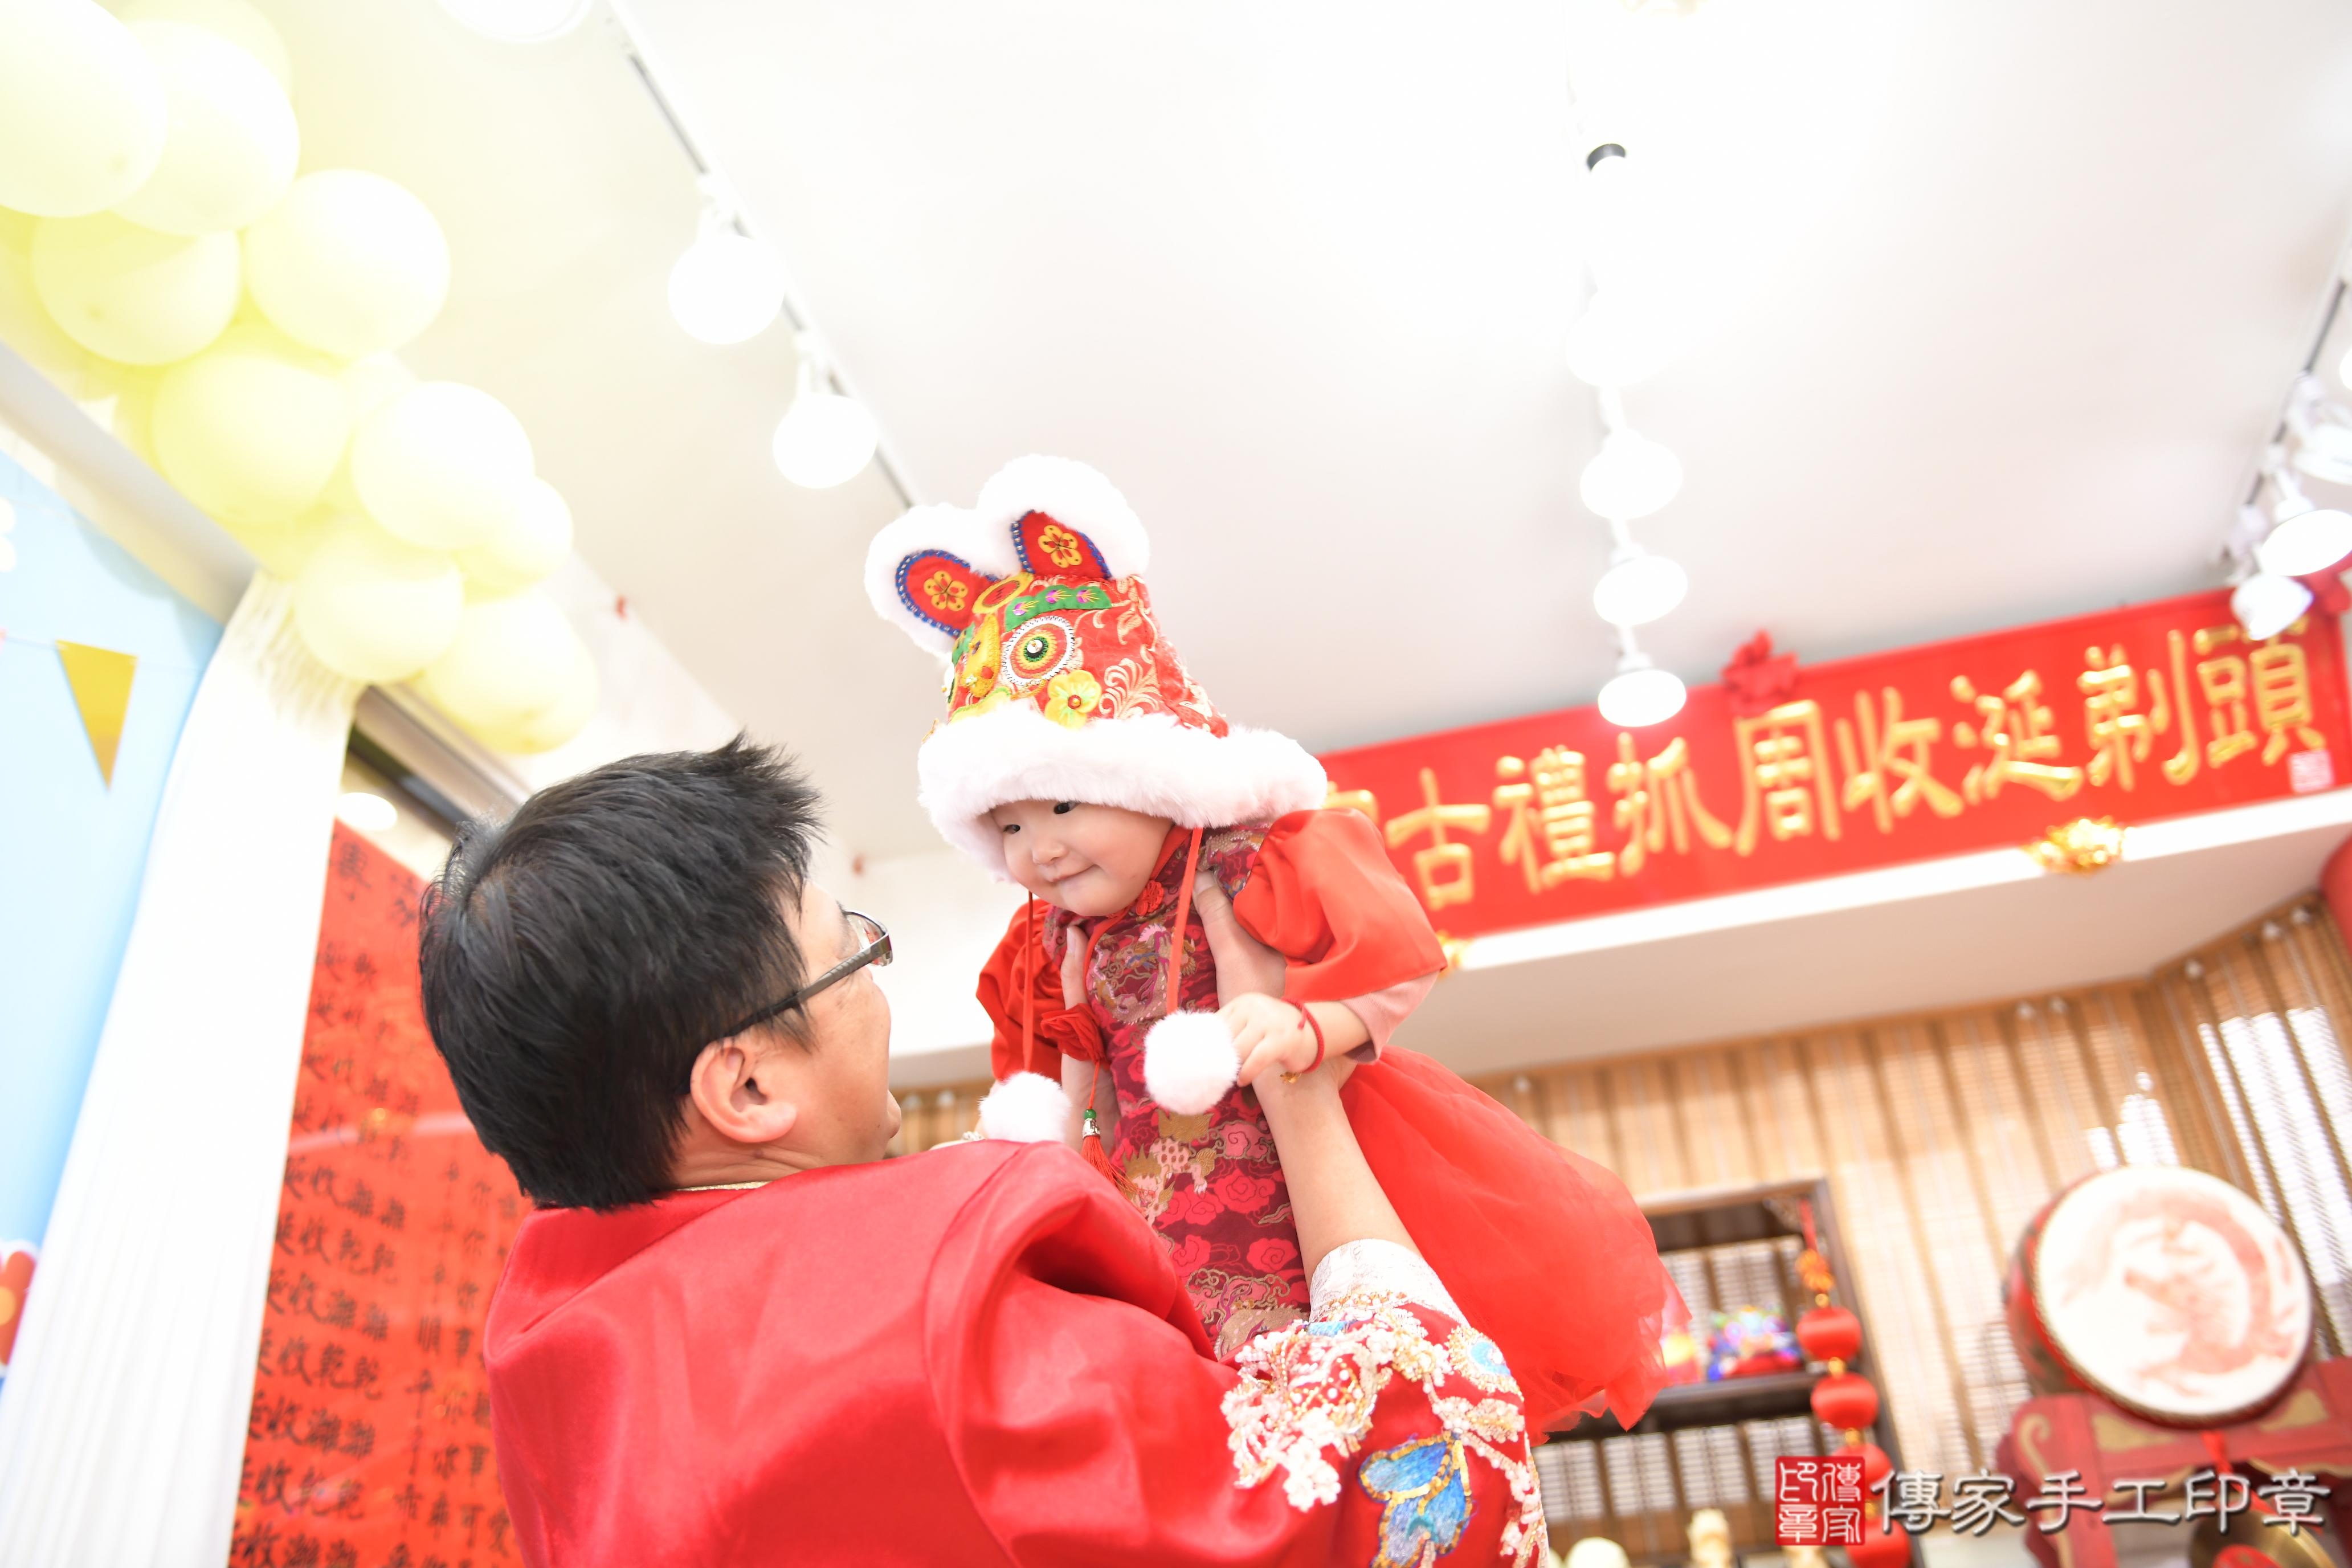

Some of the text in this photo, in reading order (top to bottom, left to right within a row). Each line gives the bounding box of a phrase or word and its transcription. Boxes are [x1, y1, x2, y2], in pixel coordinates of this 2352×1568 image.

[1324, 613, 2327, 913] 古禮抓周收涎剃頭
